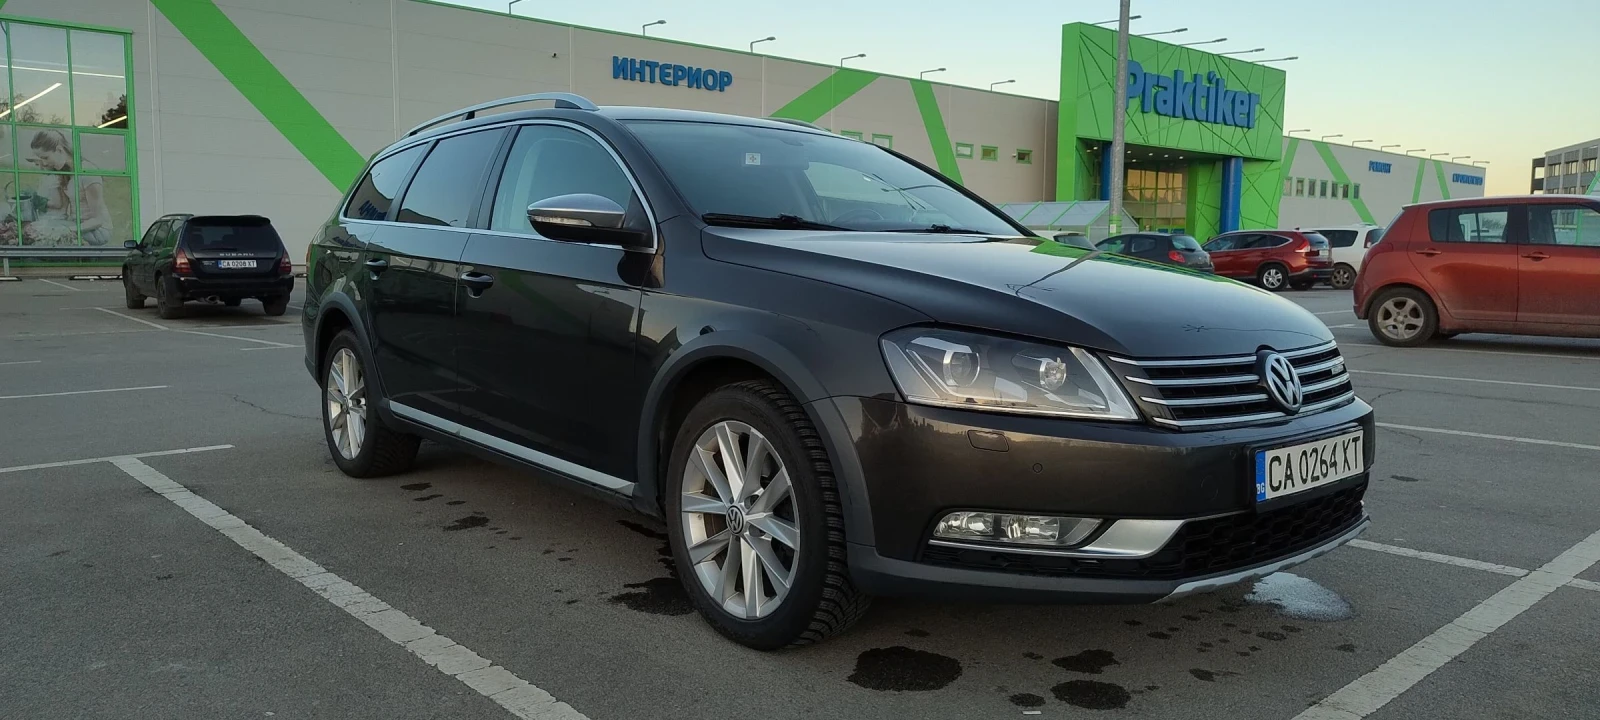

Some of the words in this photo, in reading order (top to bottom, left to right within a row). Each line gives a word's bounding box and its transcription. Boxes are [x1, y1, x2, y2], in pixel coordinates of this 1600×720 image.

[612, 56, 733, 92] ИНТЕРИОР
[1126, 59, 1260, 129] Praktiker
[1269, 453, 1295, 492] CA
[1299, 442, 1338, 485] 0264
[1342, 436, 1361, 474] XT
[1256, 482, 1265, 494] BG
